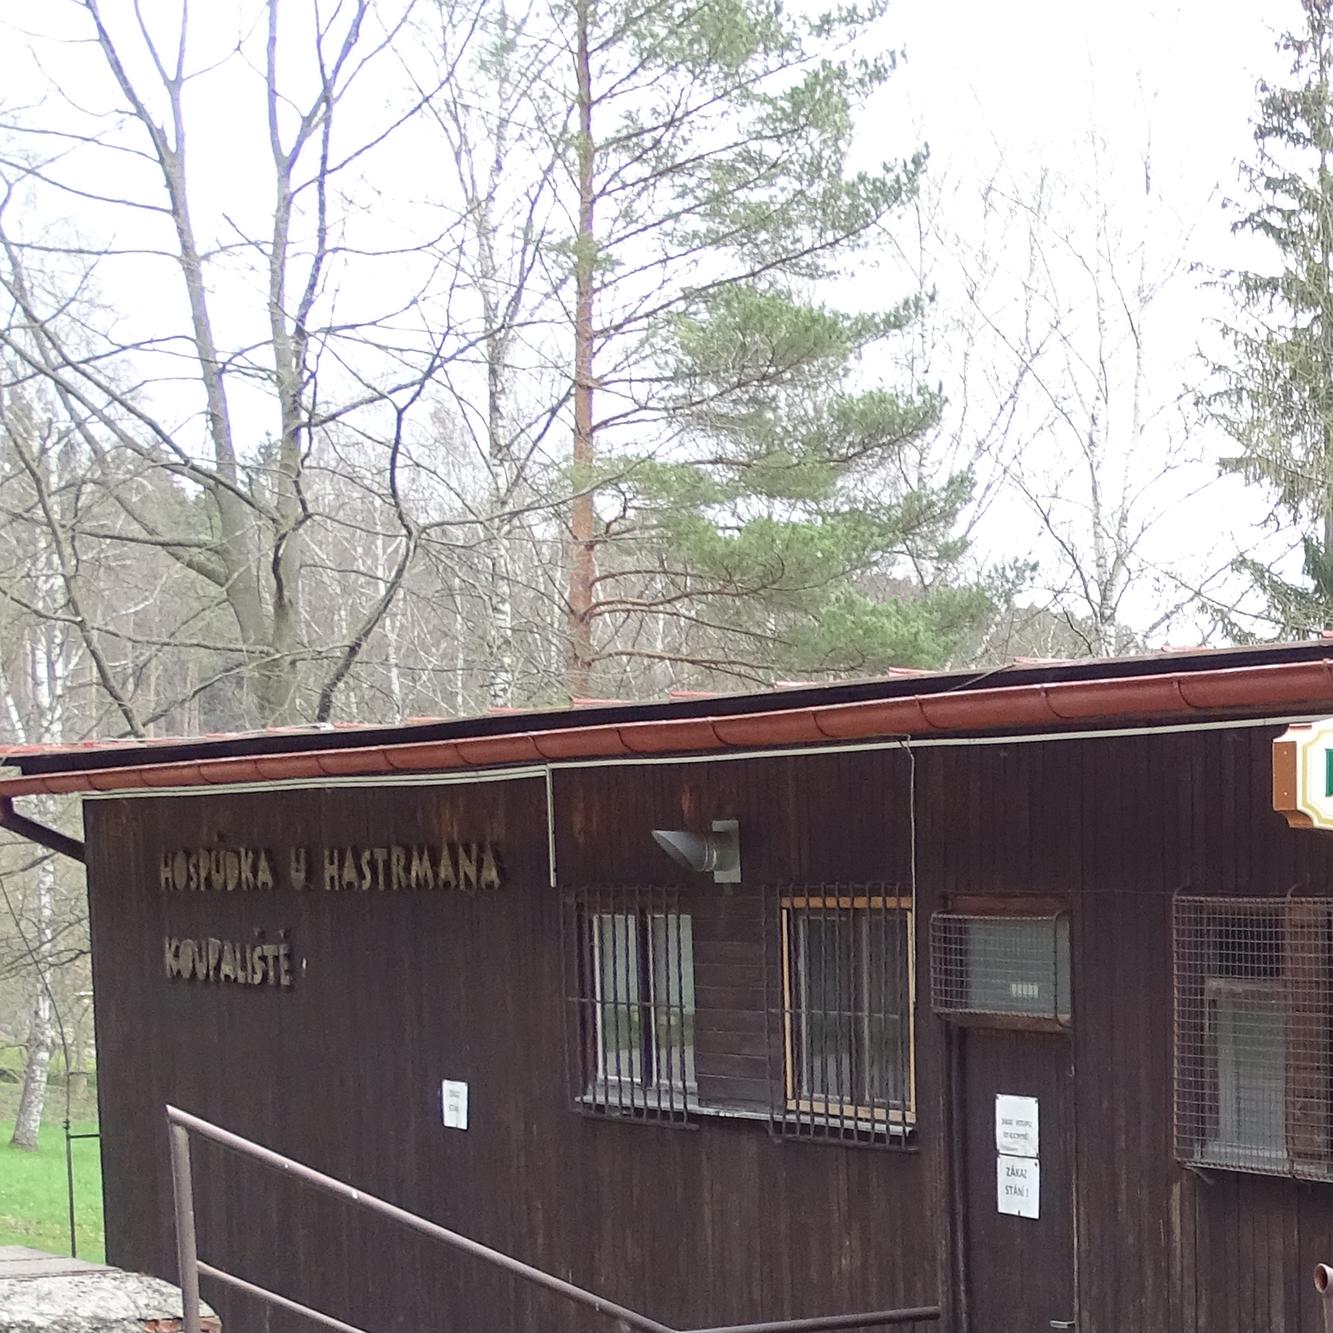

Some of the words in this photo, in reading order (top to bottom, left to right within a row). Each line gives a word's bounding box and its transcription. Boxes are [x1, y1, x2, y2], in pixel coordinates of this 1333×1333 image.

[323, 842, 502, 892] HASTRMANA
[164, 927, 292, 987] KOUPALIŠTĚ
[1006, 1165, 1028, 1179] ZÁKAZ
